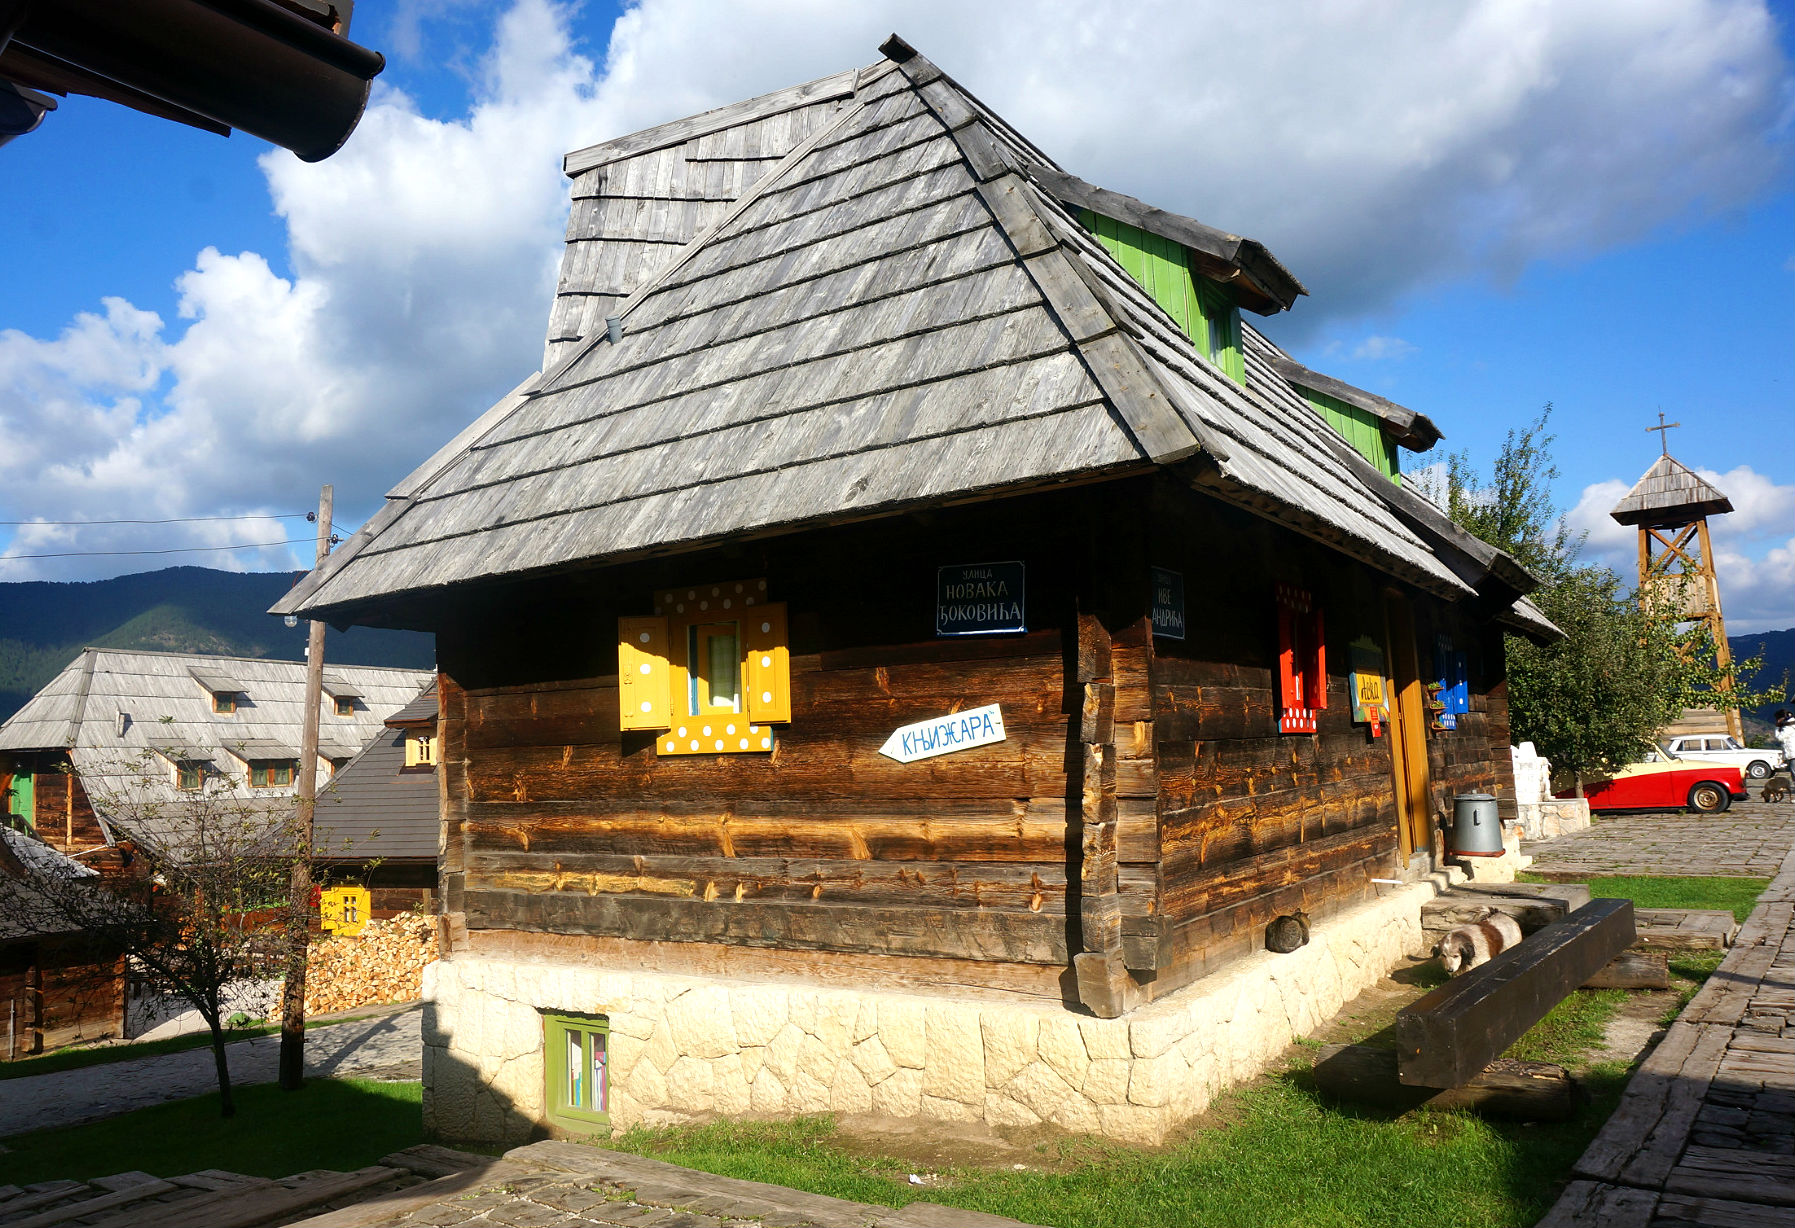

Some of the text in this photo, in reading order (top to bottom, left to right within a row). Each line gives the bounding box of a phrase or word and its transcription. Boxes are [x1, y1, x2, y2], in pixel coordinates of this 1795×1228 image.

[962, 568, 993, 580] УЛИЦА
[945, 580, 1009, 600] НОВАКА
[939, 602, 1022, 626] ЂОКОВИЋА
[1152, 607, 1183, 629] АНДРИЋА
[902, 713, 995, 756] КЊИЖАРА
